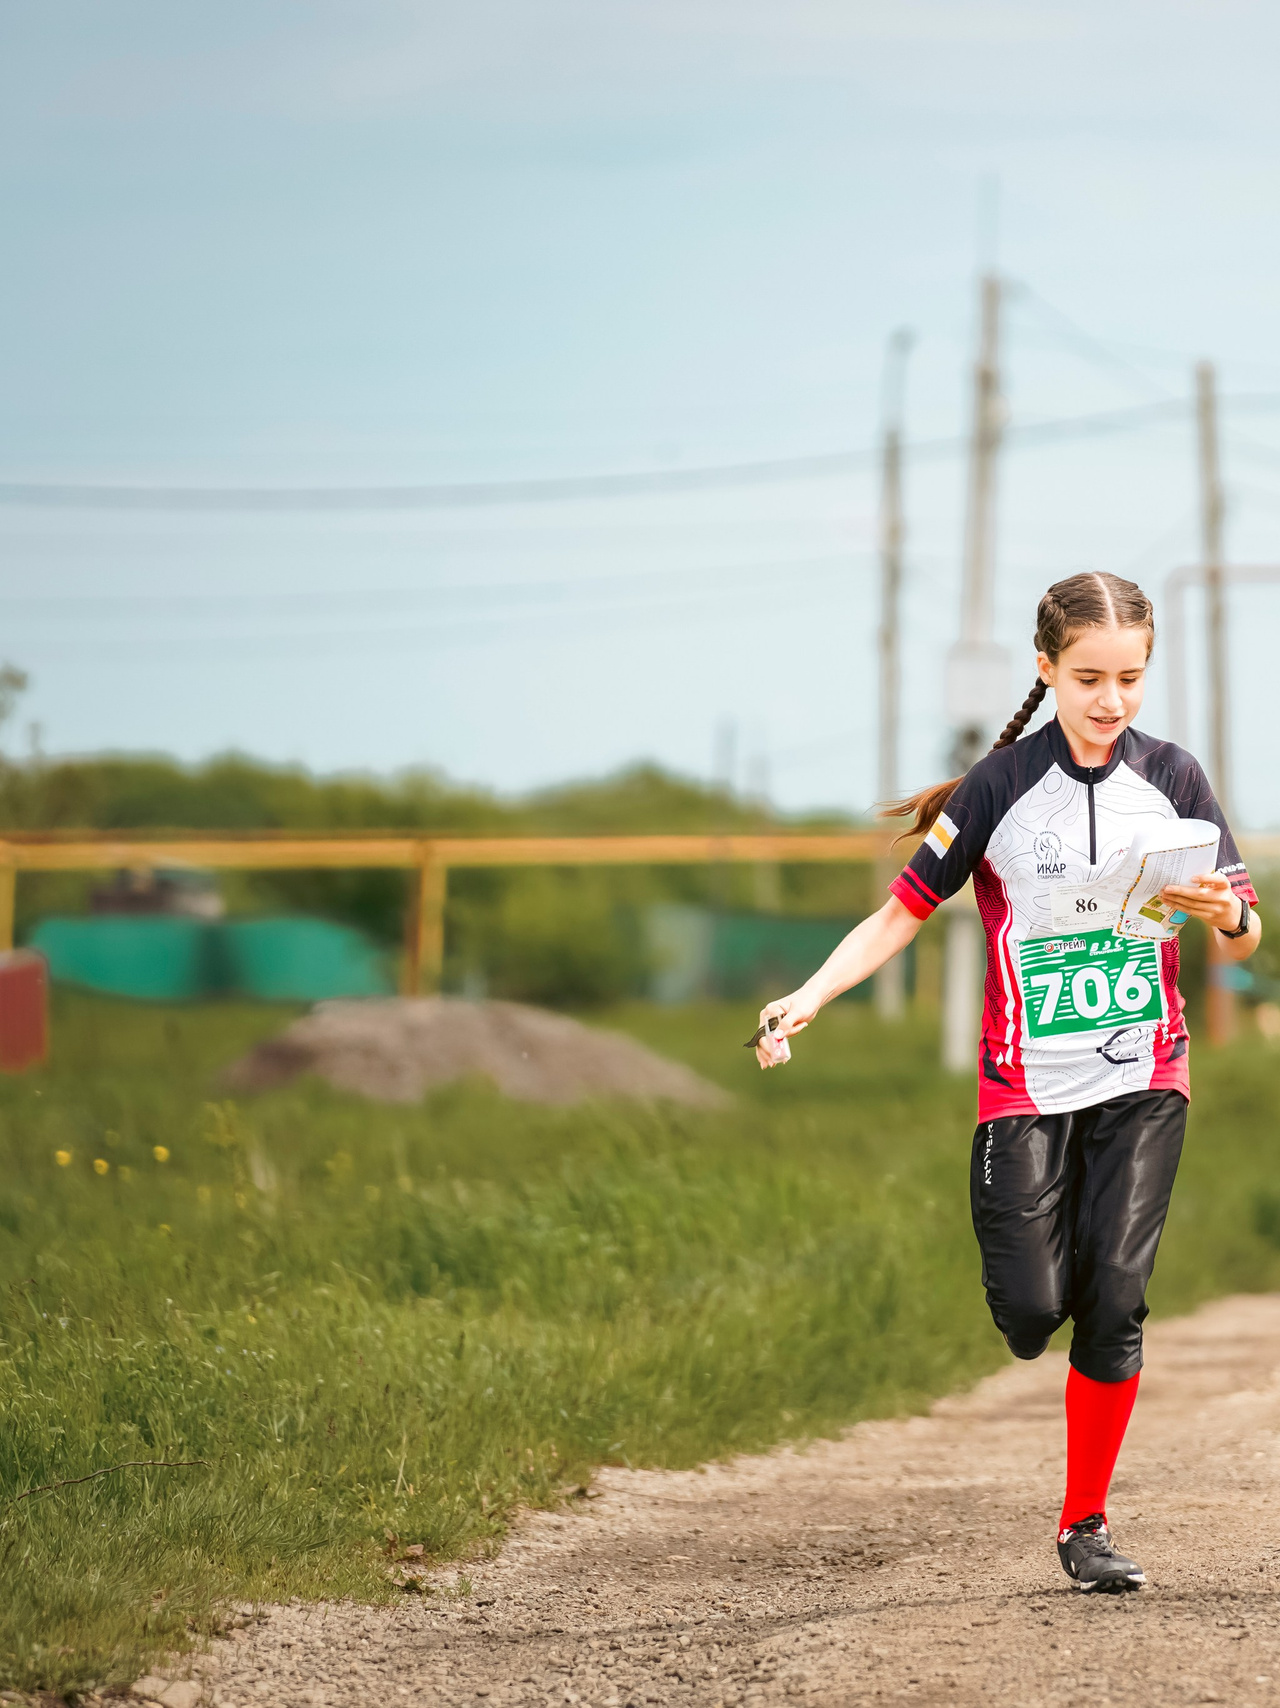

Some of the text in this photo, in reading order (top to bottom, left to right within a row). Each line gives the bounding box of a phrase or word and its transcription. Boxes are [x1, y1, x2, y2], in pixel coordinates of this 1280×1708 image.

[1037, 863, 1067, 874] ИКАР
[1075, 897, 1098, 913] 86
[1030, 959, 1152, 1026] 706
